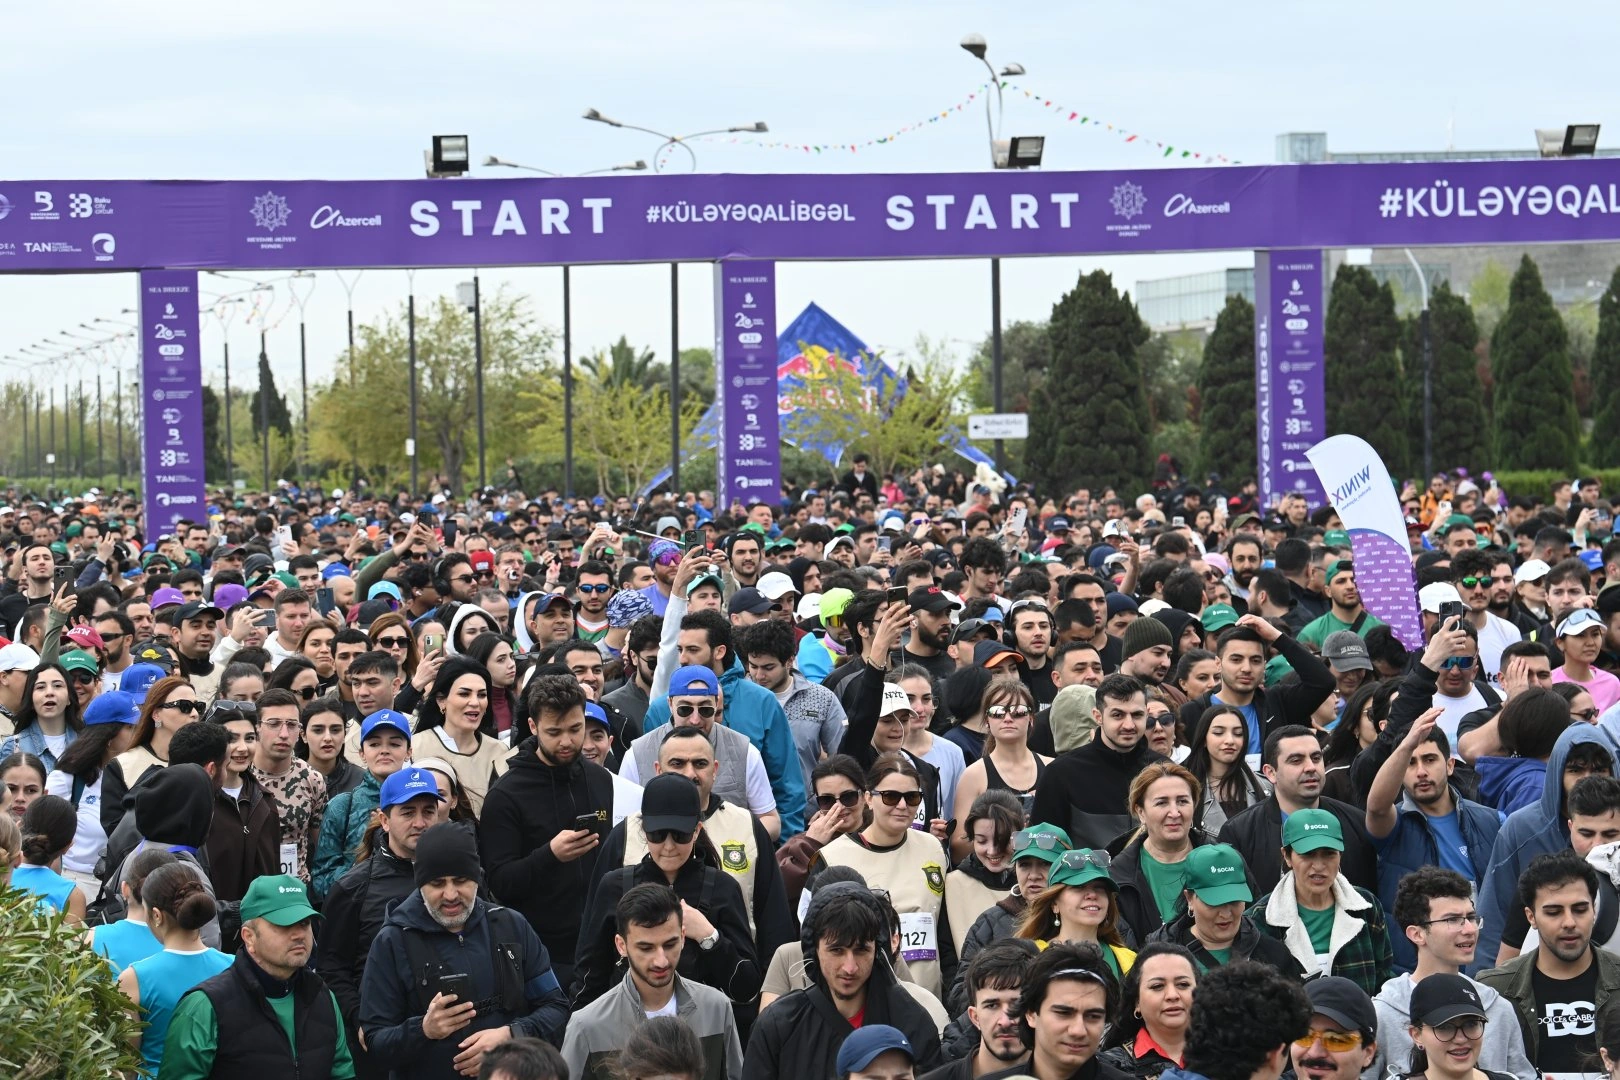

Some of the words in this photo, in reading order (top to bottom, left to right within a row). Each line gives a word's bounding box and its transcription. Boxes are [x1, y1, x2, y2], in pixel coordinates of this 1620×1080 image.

[646, 200, 856, 224] #KÜLƏYƏQALİBGƏL
[887, 194, 1079, 231] START
[1187, 201, 1231, 214] Azercell
[336, 215, 382, 227] Azercell
[410, 198, 612, 237] START
[24, 242, 52, 253] TAN
[900, 931, 927, 947] 127
